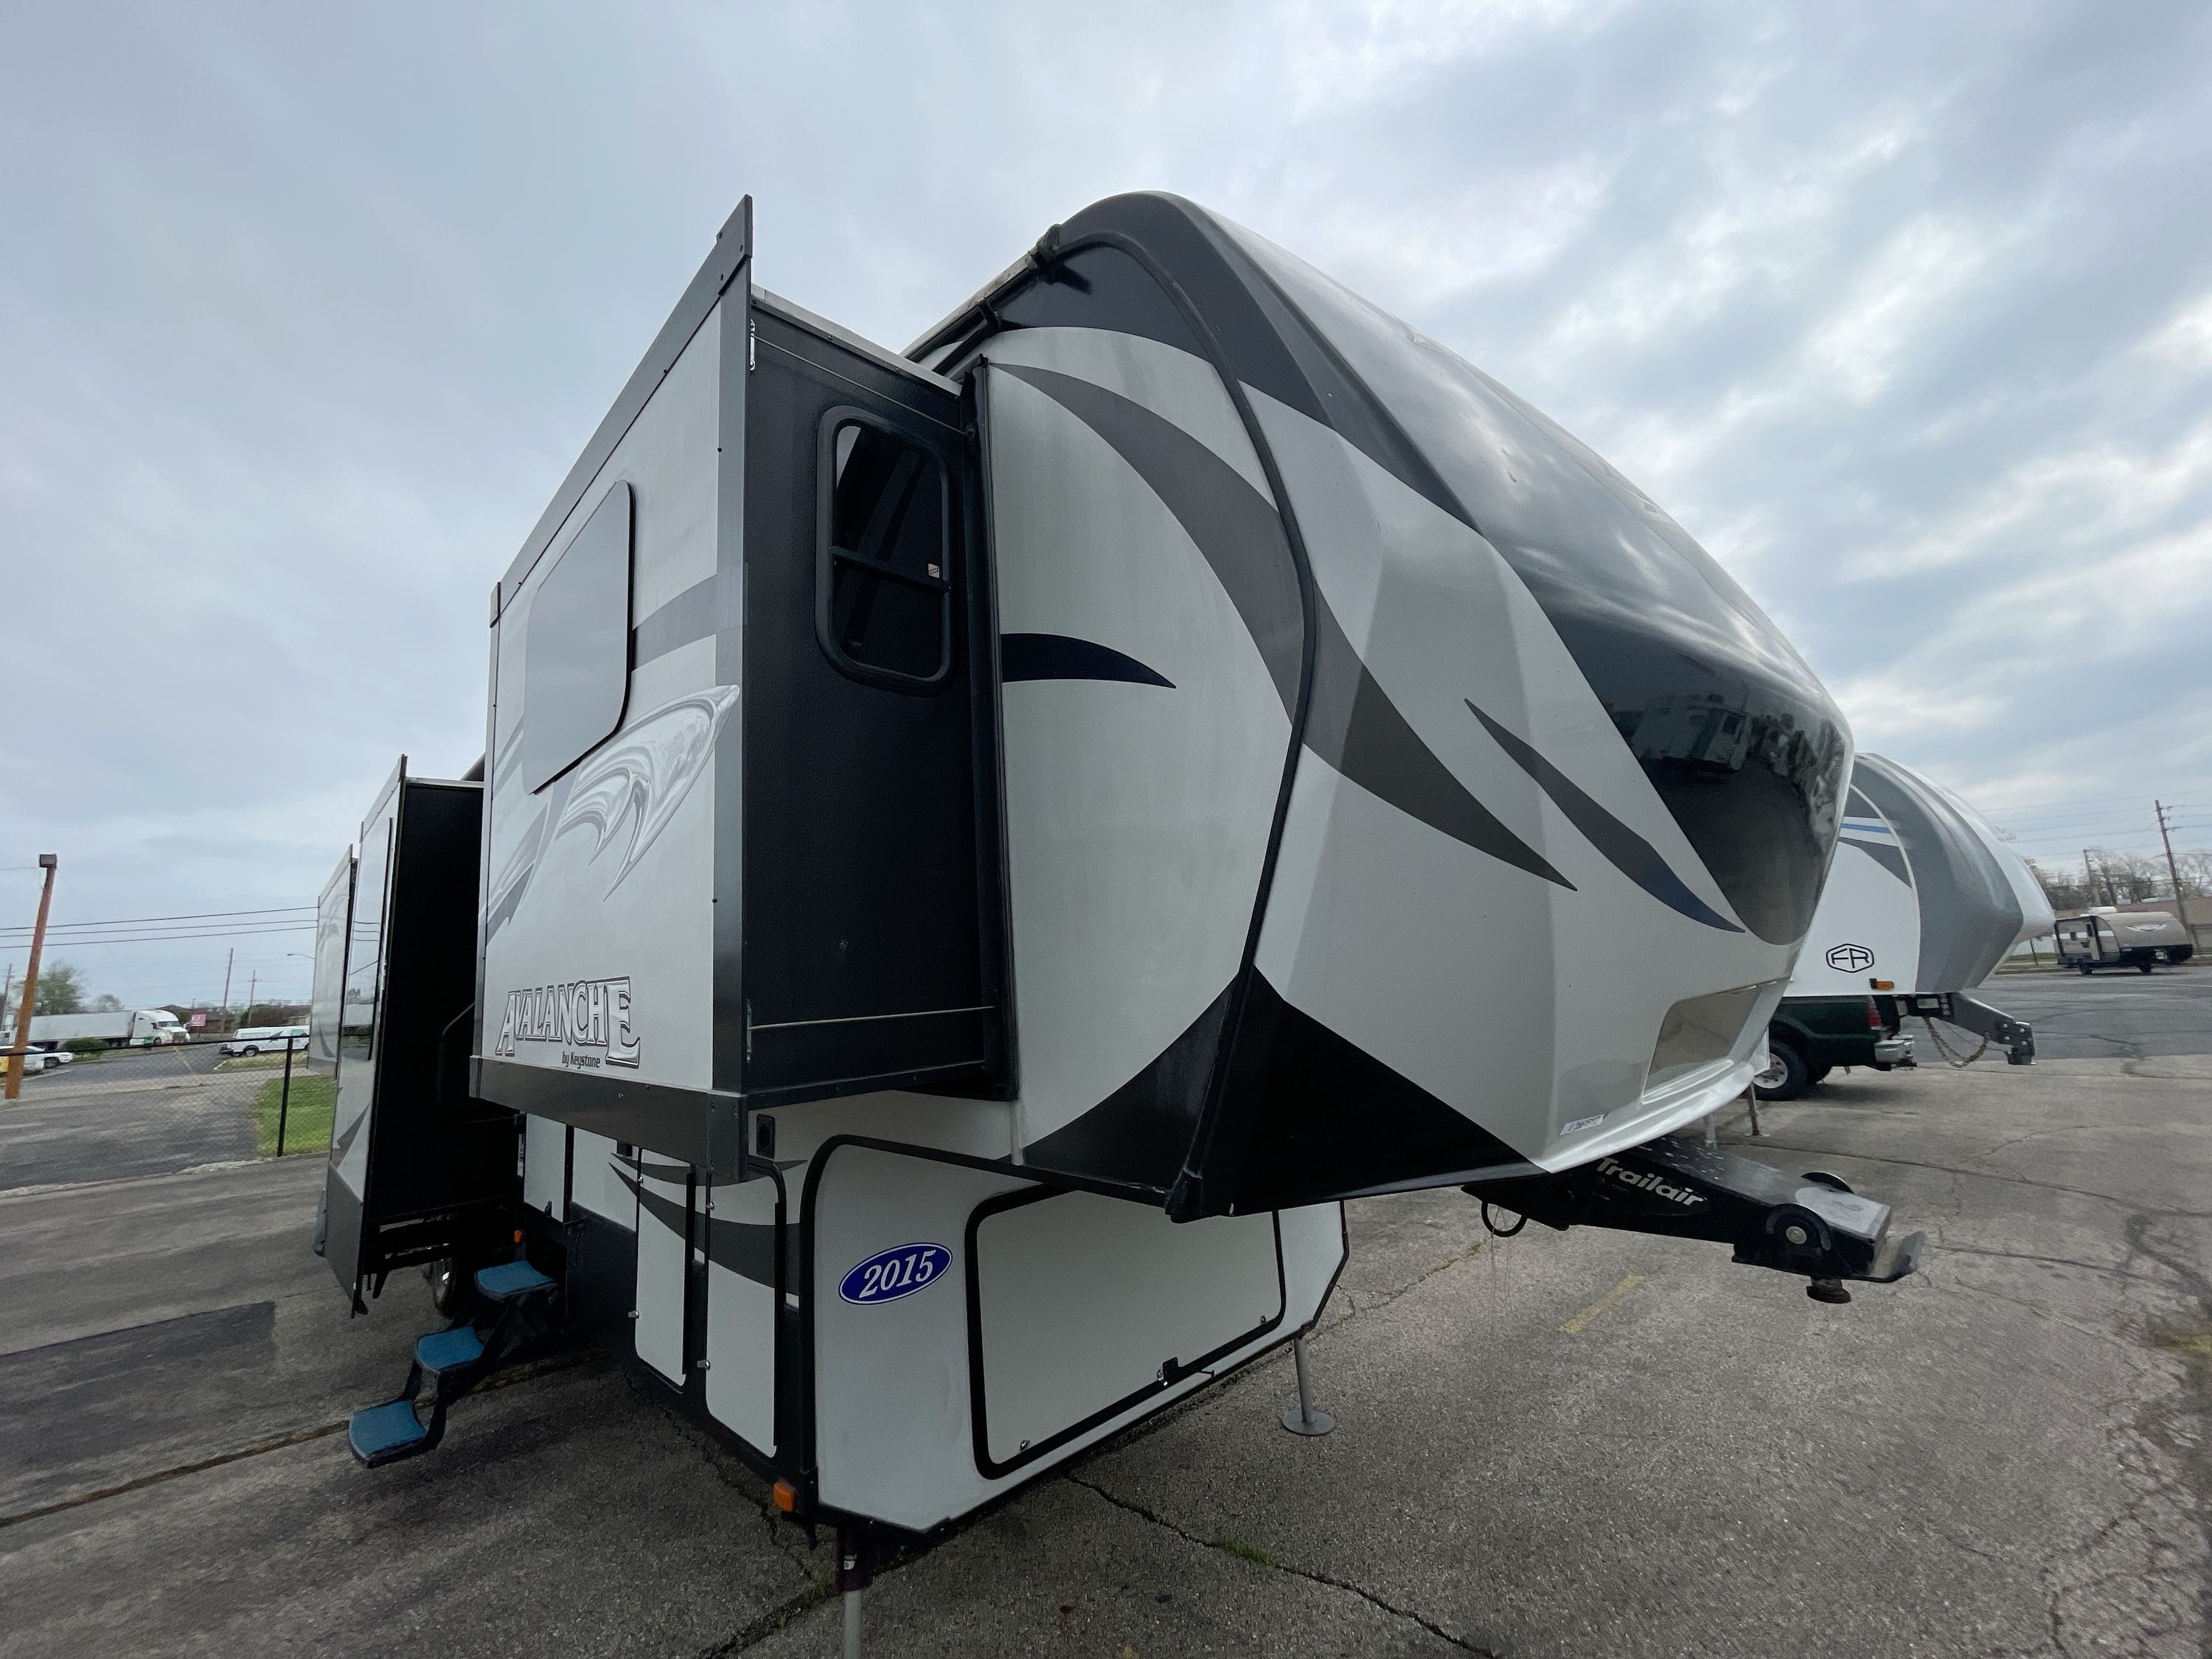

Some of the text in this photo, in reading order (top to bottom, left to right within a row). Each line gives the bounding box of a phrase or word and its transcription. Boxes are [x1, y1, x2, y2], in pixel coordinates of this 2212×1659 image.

[495, 975, 641, 1069] AVALANCHE
[562, 1051, 601, 1069] by Keystone
[1596, 1157, 1707, 1206] Trailair
[858, 1249, 936, 1298] 2015
